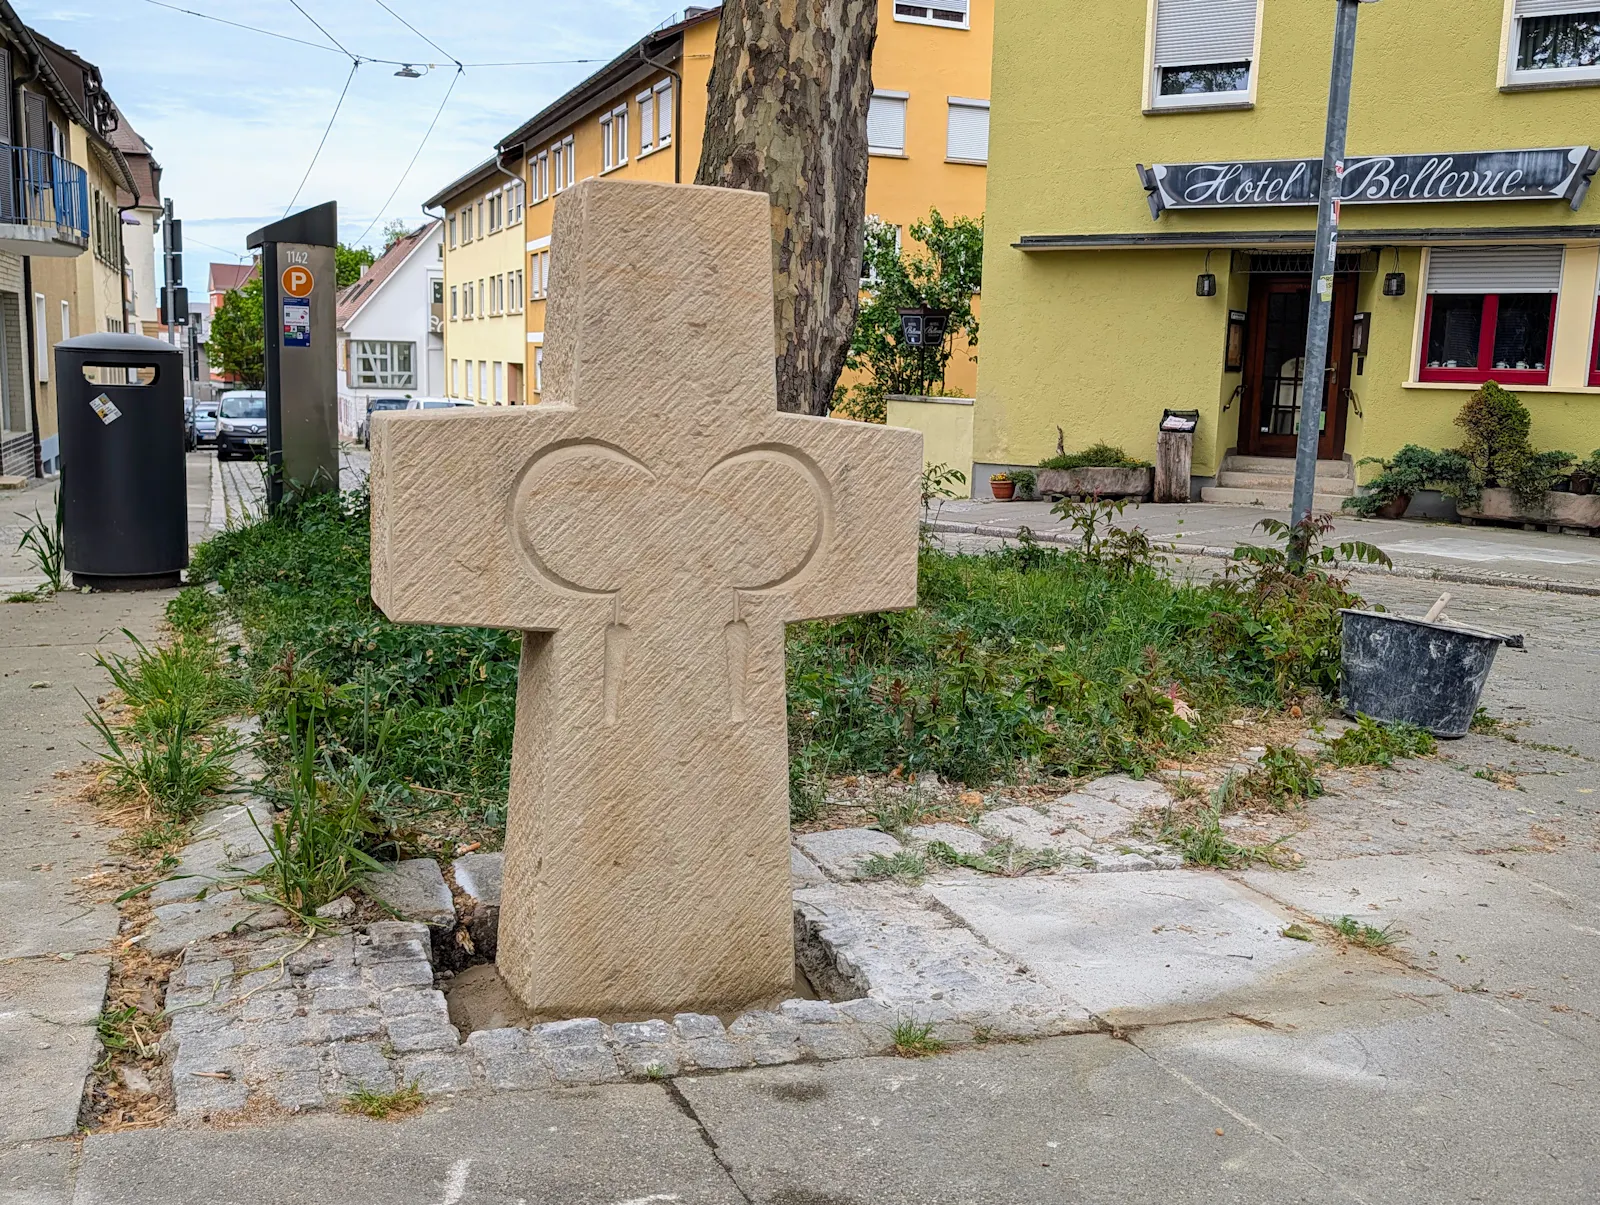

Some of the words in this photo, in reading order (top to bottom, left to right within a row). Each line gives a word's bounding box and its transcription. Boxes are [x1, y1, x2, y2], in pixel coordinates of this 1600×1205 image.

[1184, 162, 1307, 204] Hotel
[1340, 156, 1524, 200] Bellevue
[286, 250, 308, 264] 1142
[291, 271, 307, 291] P
